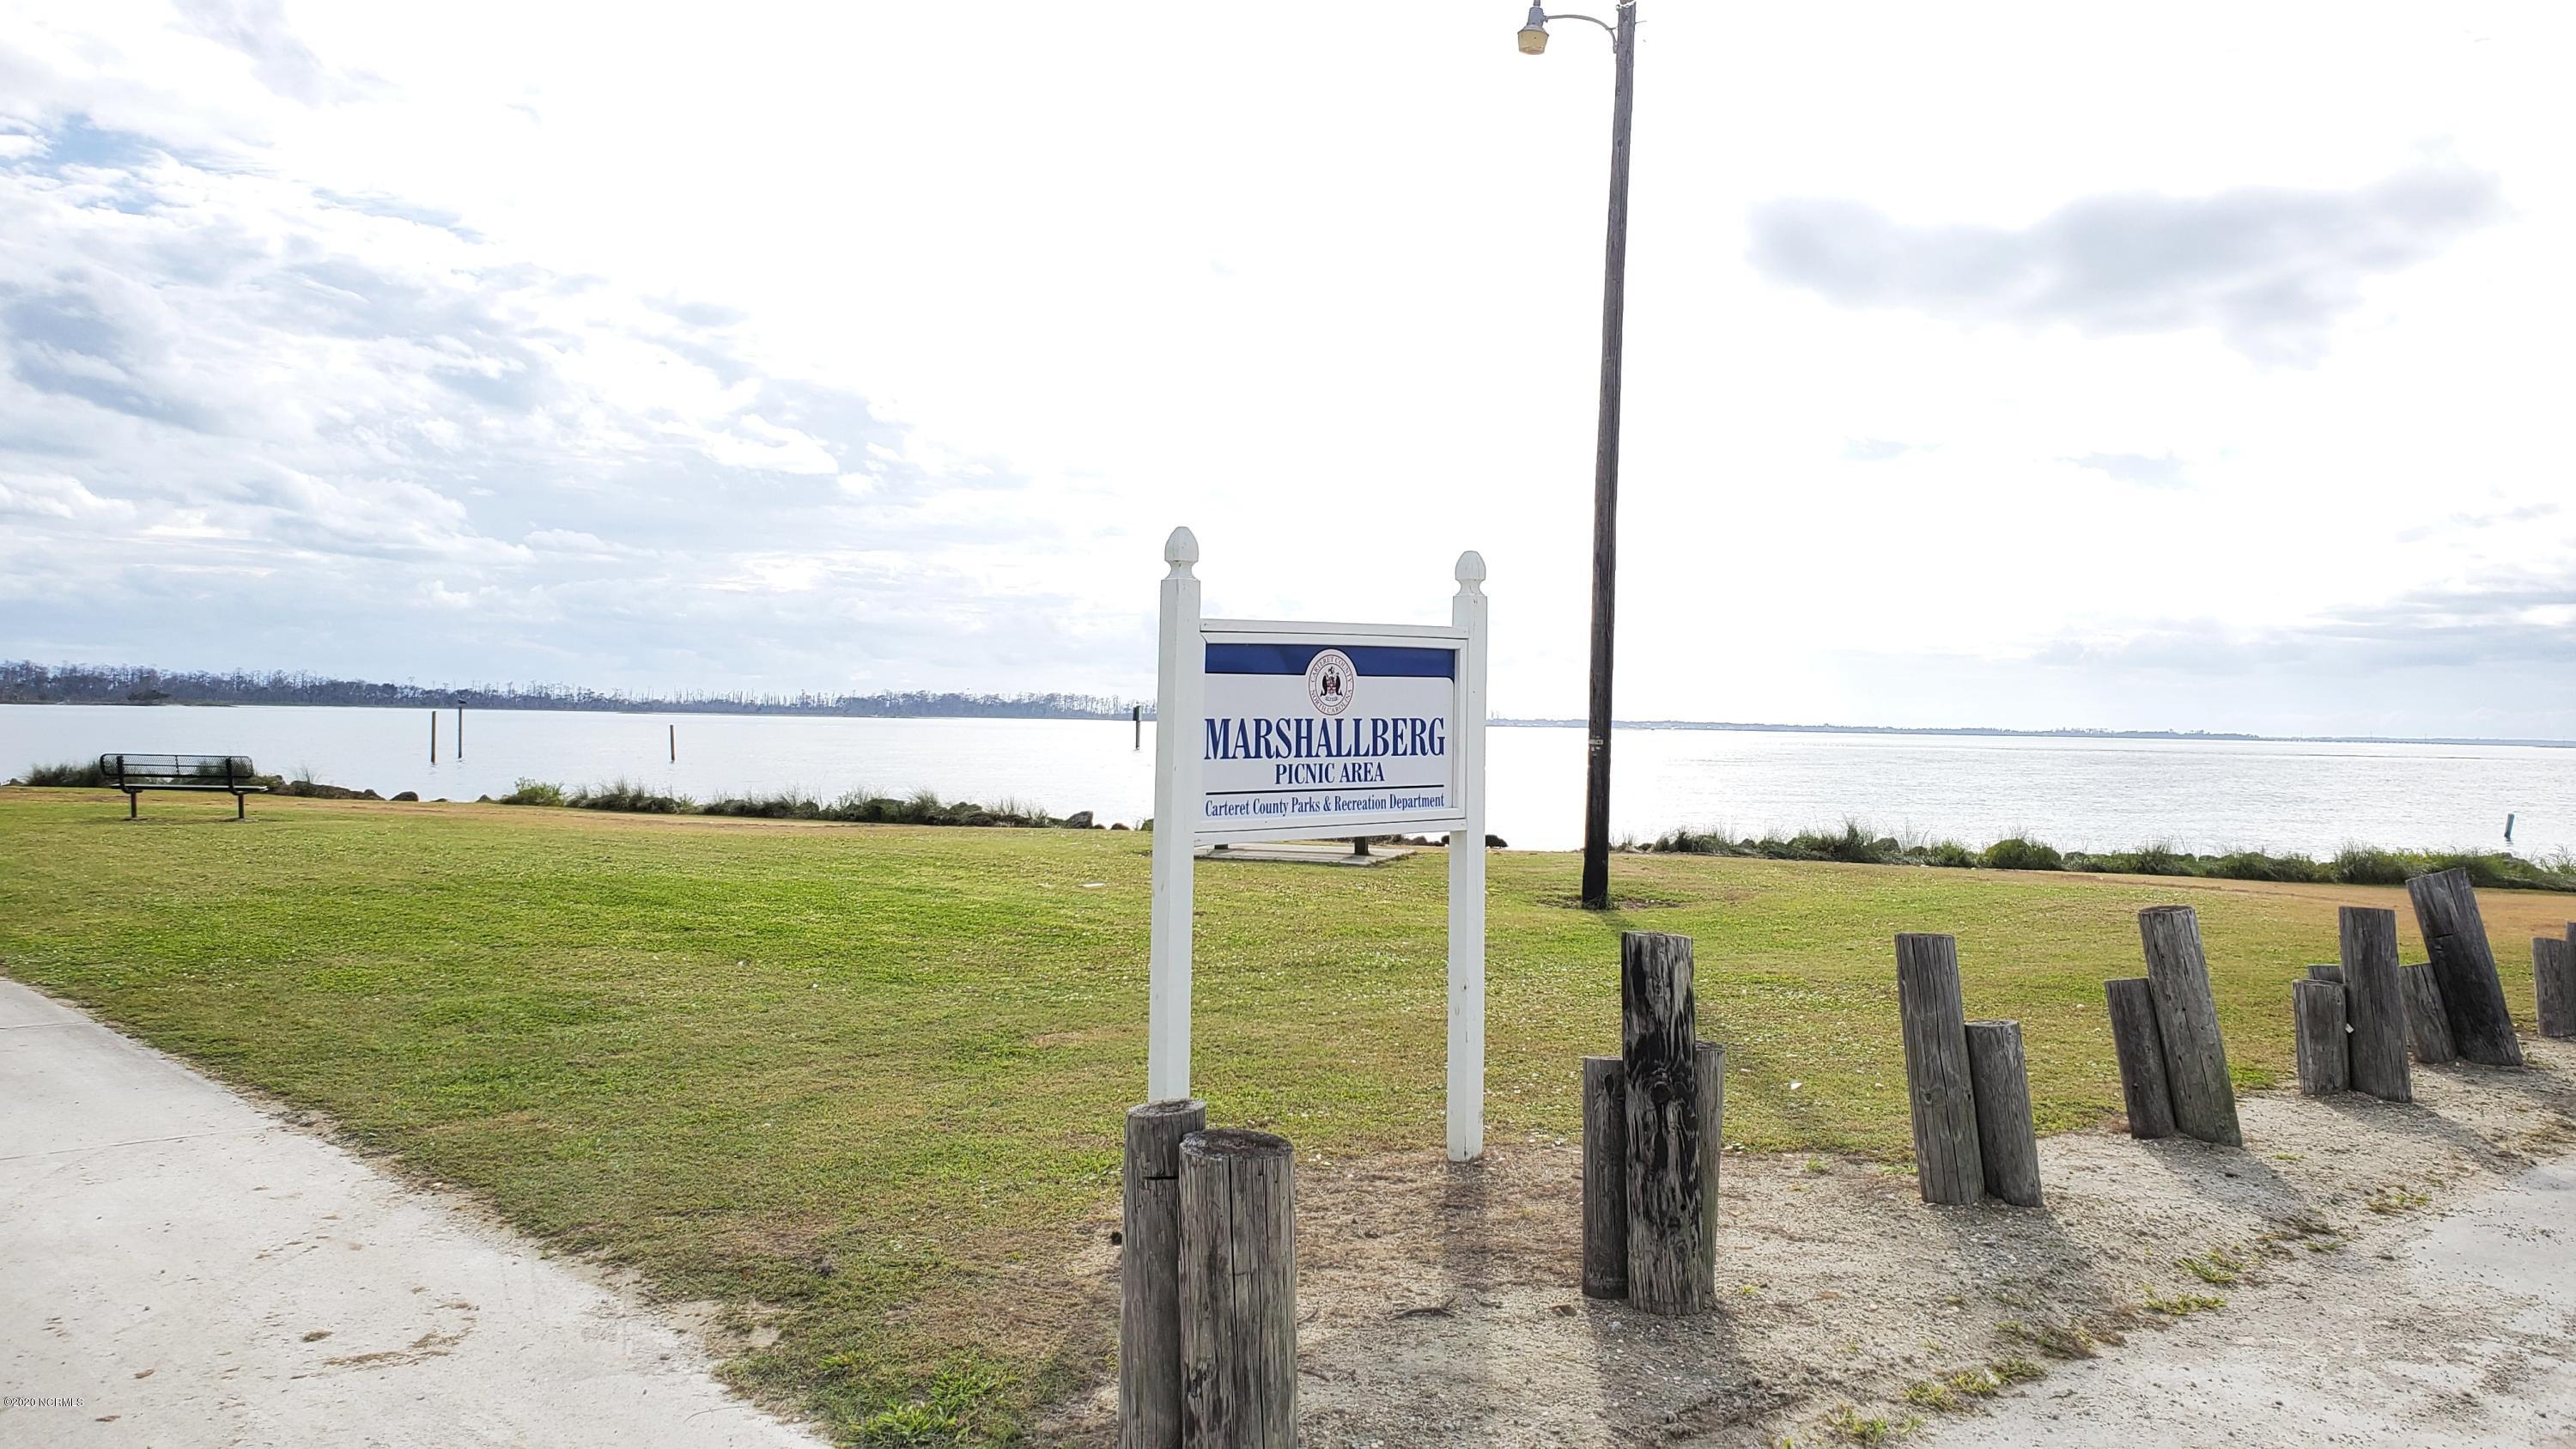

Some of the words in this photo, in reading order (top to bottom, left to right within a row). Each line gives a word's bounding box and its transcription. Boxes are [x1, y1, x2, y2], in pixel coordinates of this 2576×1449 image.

[1311, 657, 1334, 683] CARTERET
[1335, 657, 1352, 682] COUNTY
[1311, 689, 1326, 711] NORTH
[1327, 689, 1352, 713] CAROLINA
[1204, 717, 1445, 759] MARSHALLBERG
[1275, 763, 1335, 784] PICNIC
[1339, 762, 1385, 782] AREA
[1206, 800, 1249, 816] Carteret
[1253, 797, 1289, 816] County
[1291, 795, 1321, 813] Parks
[1323, 795, 1332, 811] &
[1334, 794, 1387, 811] Recreation
[1389, 792, 1444, 810] Department
